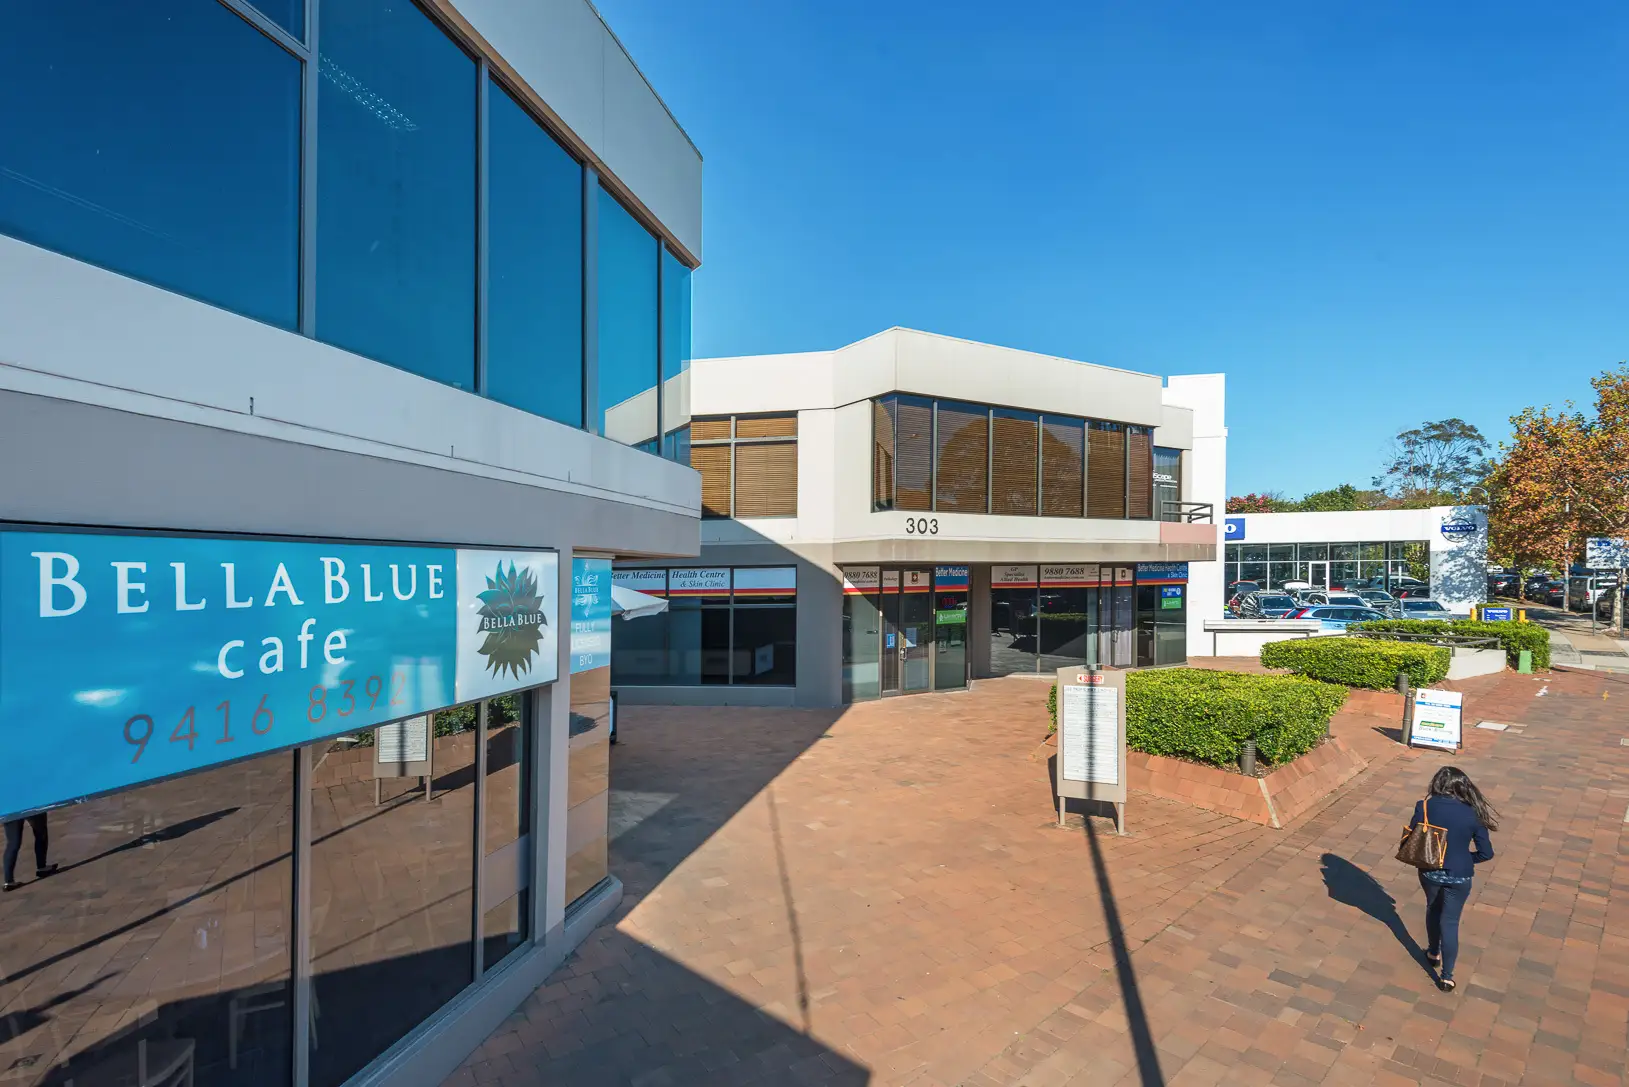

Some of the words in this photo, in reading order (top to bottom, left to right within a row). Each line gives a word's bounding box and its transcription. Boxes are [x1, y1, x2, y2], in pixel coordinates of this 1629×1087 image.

[906, 517, 939, 535] 303
[631, 571, 666, 580] Medicine
[672, 570, 698, 579] Health
[700, 570, 726, 579] Centre
[862, 571, 878, 579] 7688
[935, 566, 949, 577] Better
[948, 566, 968, 577] Medicine
[1044, 567, 1063, 575] 9880
[1065, 567, 1085, 575] 7688
[30, 551, 304, 618] BELLA
[319, 556, 445, 605] BLUE
[680, 580, 687, 588] &
[689, 580, 703, 588] Skin
[704, 579, 726, 588] Clinic
[483, 615, 516, 630] BELLA
[517, 613, 542, 626] BLUE
[575, 621, 595, 633] FULLY
[217, 618, 349, 680] cafe
[580, 653, 593, 666] BYO
[123, 693, 274, 764] 9416
[306, 671, 406, 724] 8392
